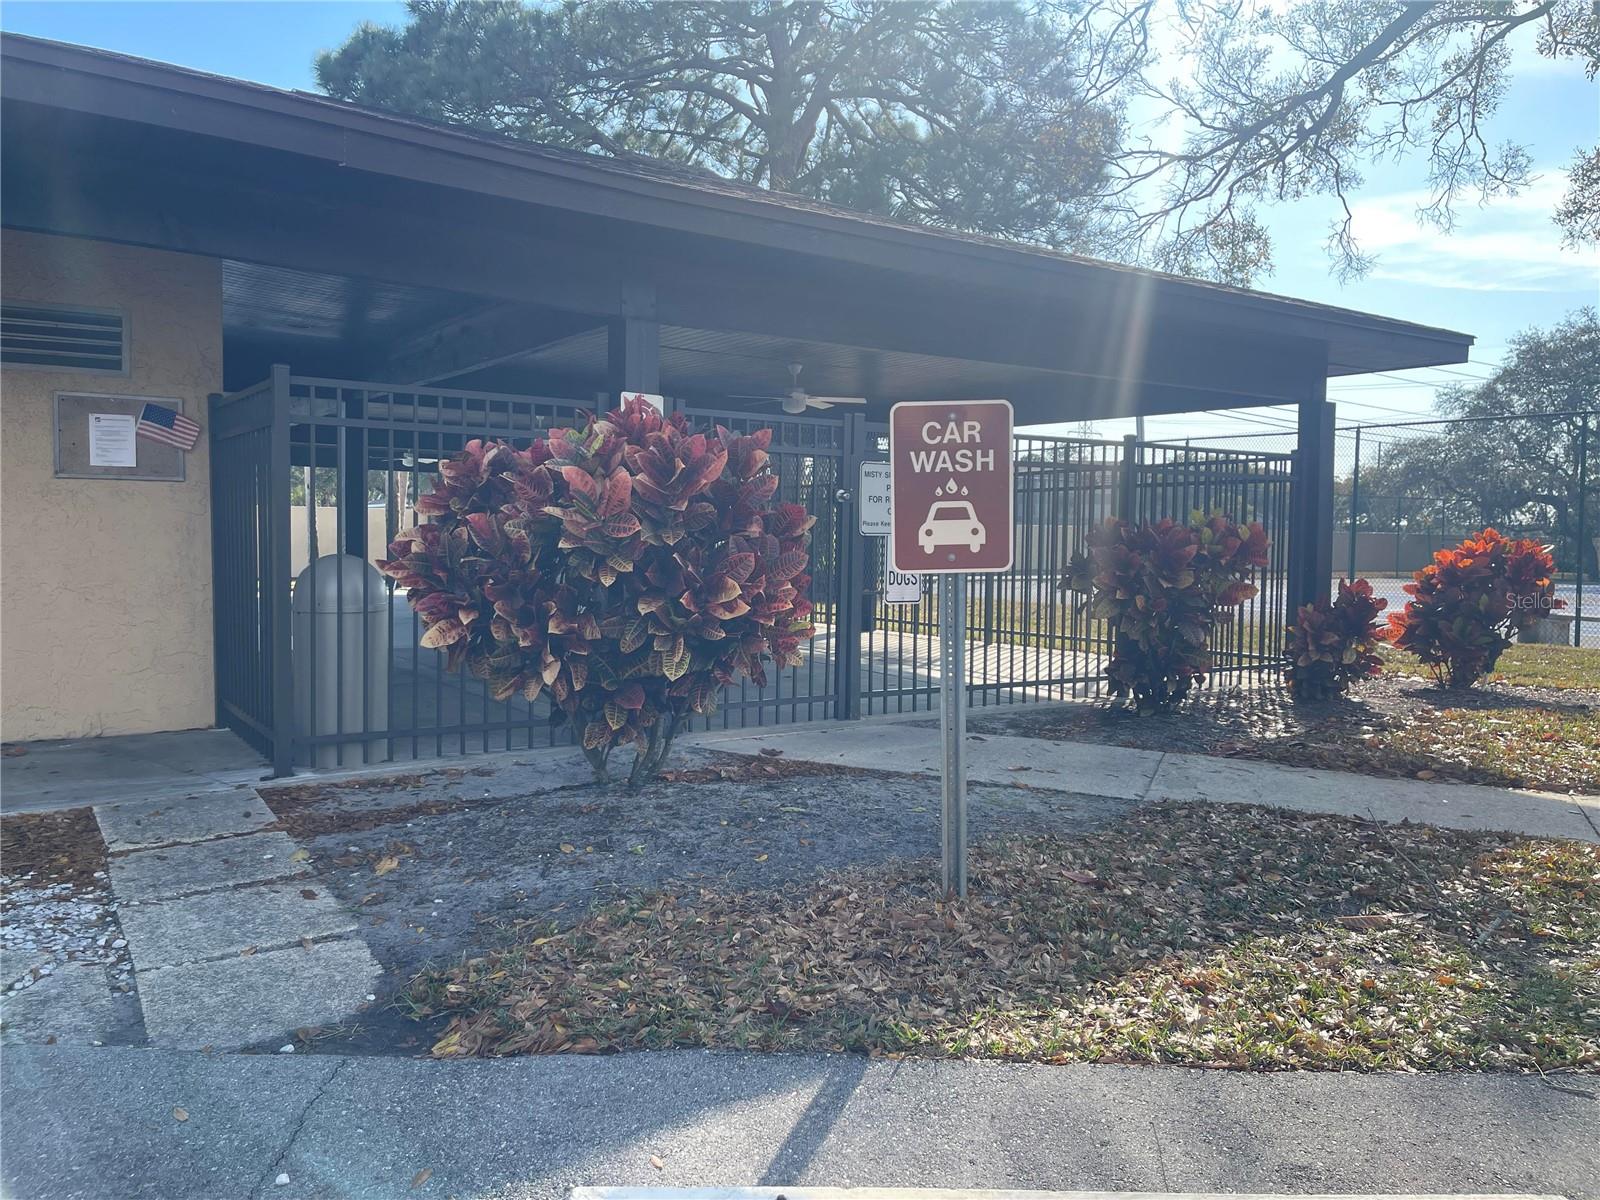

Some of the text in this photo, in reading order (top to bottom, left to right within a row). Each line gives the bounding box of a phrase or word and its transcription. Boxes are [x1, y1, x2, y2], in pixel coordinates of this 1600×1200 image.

[922, 421, 981, 444] CAR
[909, 449, 994, 472] WASH
[864, 470, 882, 478] MISTY
[868, 495, 883, 503] FOR
[889, 570, 918, 586] DOGS
